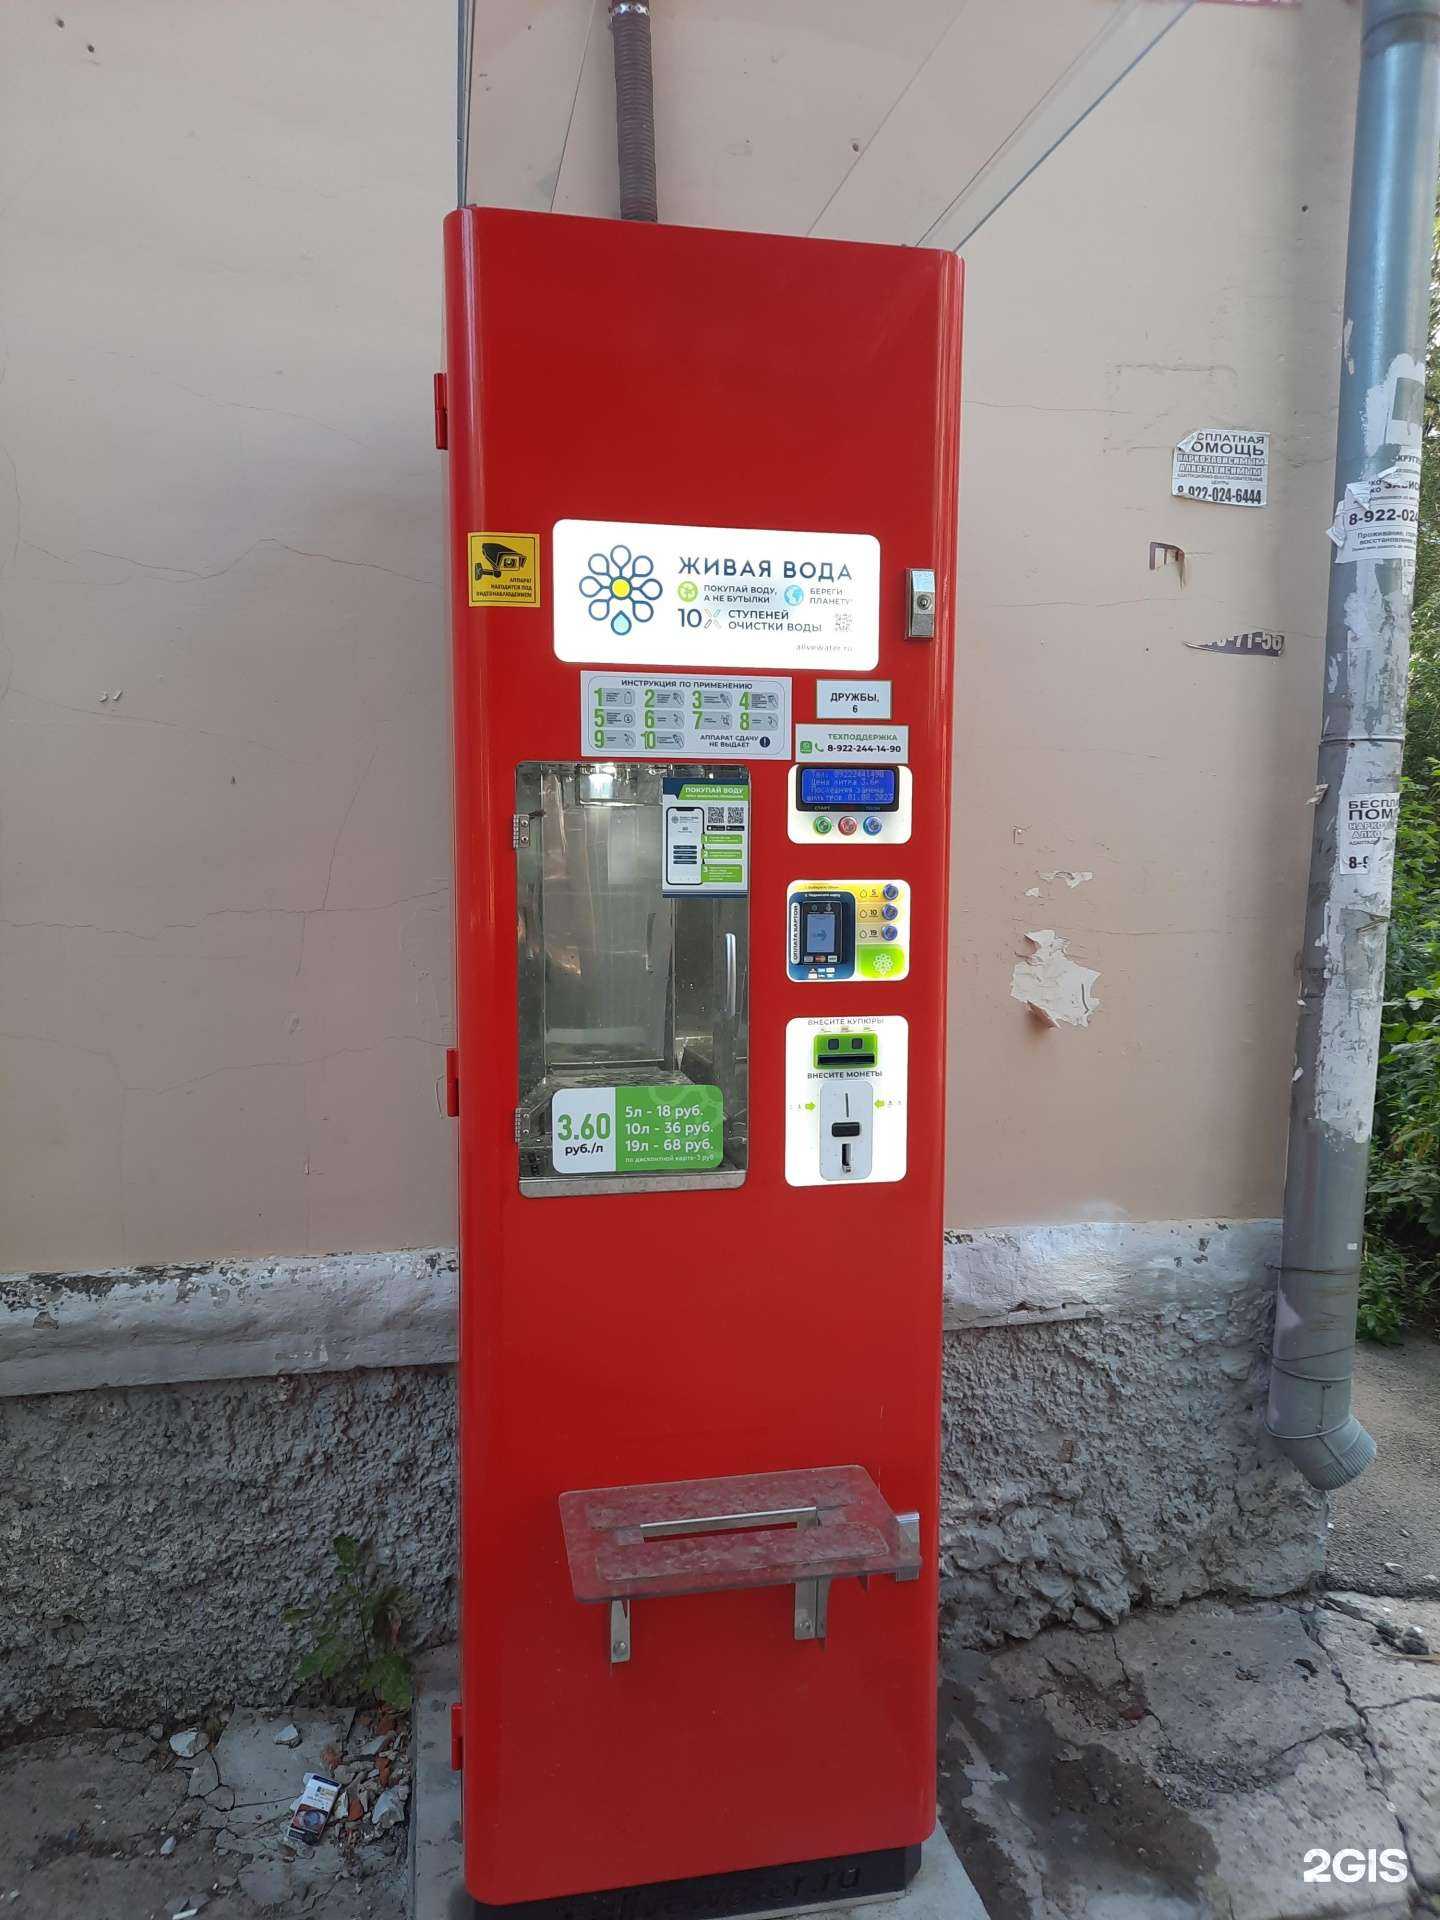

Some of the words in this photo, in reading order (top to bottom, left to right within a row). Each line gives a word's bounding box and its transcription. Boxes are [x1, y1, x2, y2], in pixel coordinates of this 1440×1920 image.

[1197, 432, 1265, 444] СПЛАТНАЯ
[1191, 441, 1265, 457] ОМОЩЬ
[1177, 485, 1262, 505] 8922-024-6444
[677, 556, 772, 578] ЖИВАЯ
[783, 560, 853, 583] ВОДА
[703, 584, 749, 594] ПОКУПАЙ
[750, 586, 778, 596] ВОДУ,
[703, 594, 711, 602] А
[712, 595, 725, 603] НЕ
[726, 595, 771, 604] БУТЫЛКИ
[677, 608, 703, 628] 10
[728, 608, 789, 620] СТУПЕНЕЙ
[728, 621, 784, 632] ОЧИСТКИ
[786, 623, 823, 633] ВОДЫ
[621, 679, 677, 688] ИНСТРУКЦИЯ
[693, 682, 753, 690] ПРИМЕНЕНИЮ
[594, 687, 603, 707] 1
[644, 688, 655, 708] 2
[692, 690, 702, 709] 3
[738, 691, 750, 711] 4
[830, 692, 880, 703] ДРУЖБЫ,
[852, 704, 858, 713] 6
[594, 708, 605, 728] 5
[644, 710, 655, 729] 6
[692, 710, 704, 730] 7
[739, 712, 750, 731] 8
[594, 729, 605, 749] 9
[640, 730, 657, 750] 10
[720, 741, 750, 749] ВЫДАЕТ
[828, 733, 898, 742] ТЕХПОДДЕРЖКА
[827, 744, 902, 753] 8-922-244-14-90
[685, 786, 723, 794] ПОКУПАЙ
[723, 787, 744, 795] ВОДУ
[847, 1018, 884, 1026] КУПЮРЫ
[807, 1072, 845, 1080] ВНЕСИТЕ
[846, 1071, 883, 1079] МОНЕТЫ
[625, 1105, 643, 1118] 5л
[656, 1105, 671, 1117] 18
[674, 1104, 704, 1119] руб.
[557, 1112, 611, 1141] 3.60
[625, 1122, 650, 1136] 10л
[664, 1122, 682, 1135] 36
[684, 1121, 714, 1137] руб.
[565, 1142, 604, 1157] руб./л
[625, 1139, 649, 1152] 19л
[663, 1139, 681, 1152] 68
[684, 1138, 714, 1154] руб.
